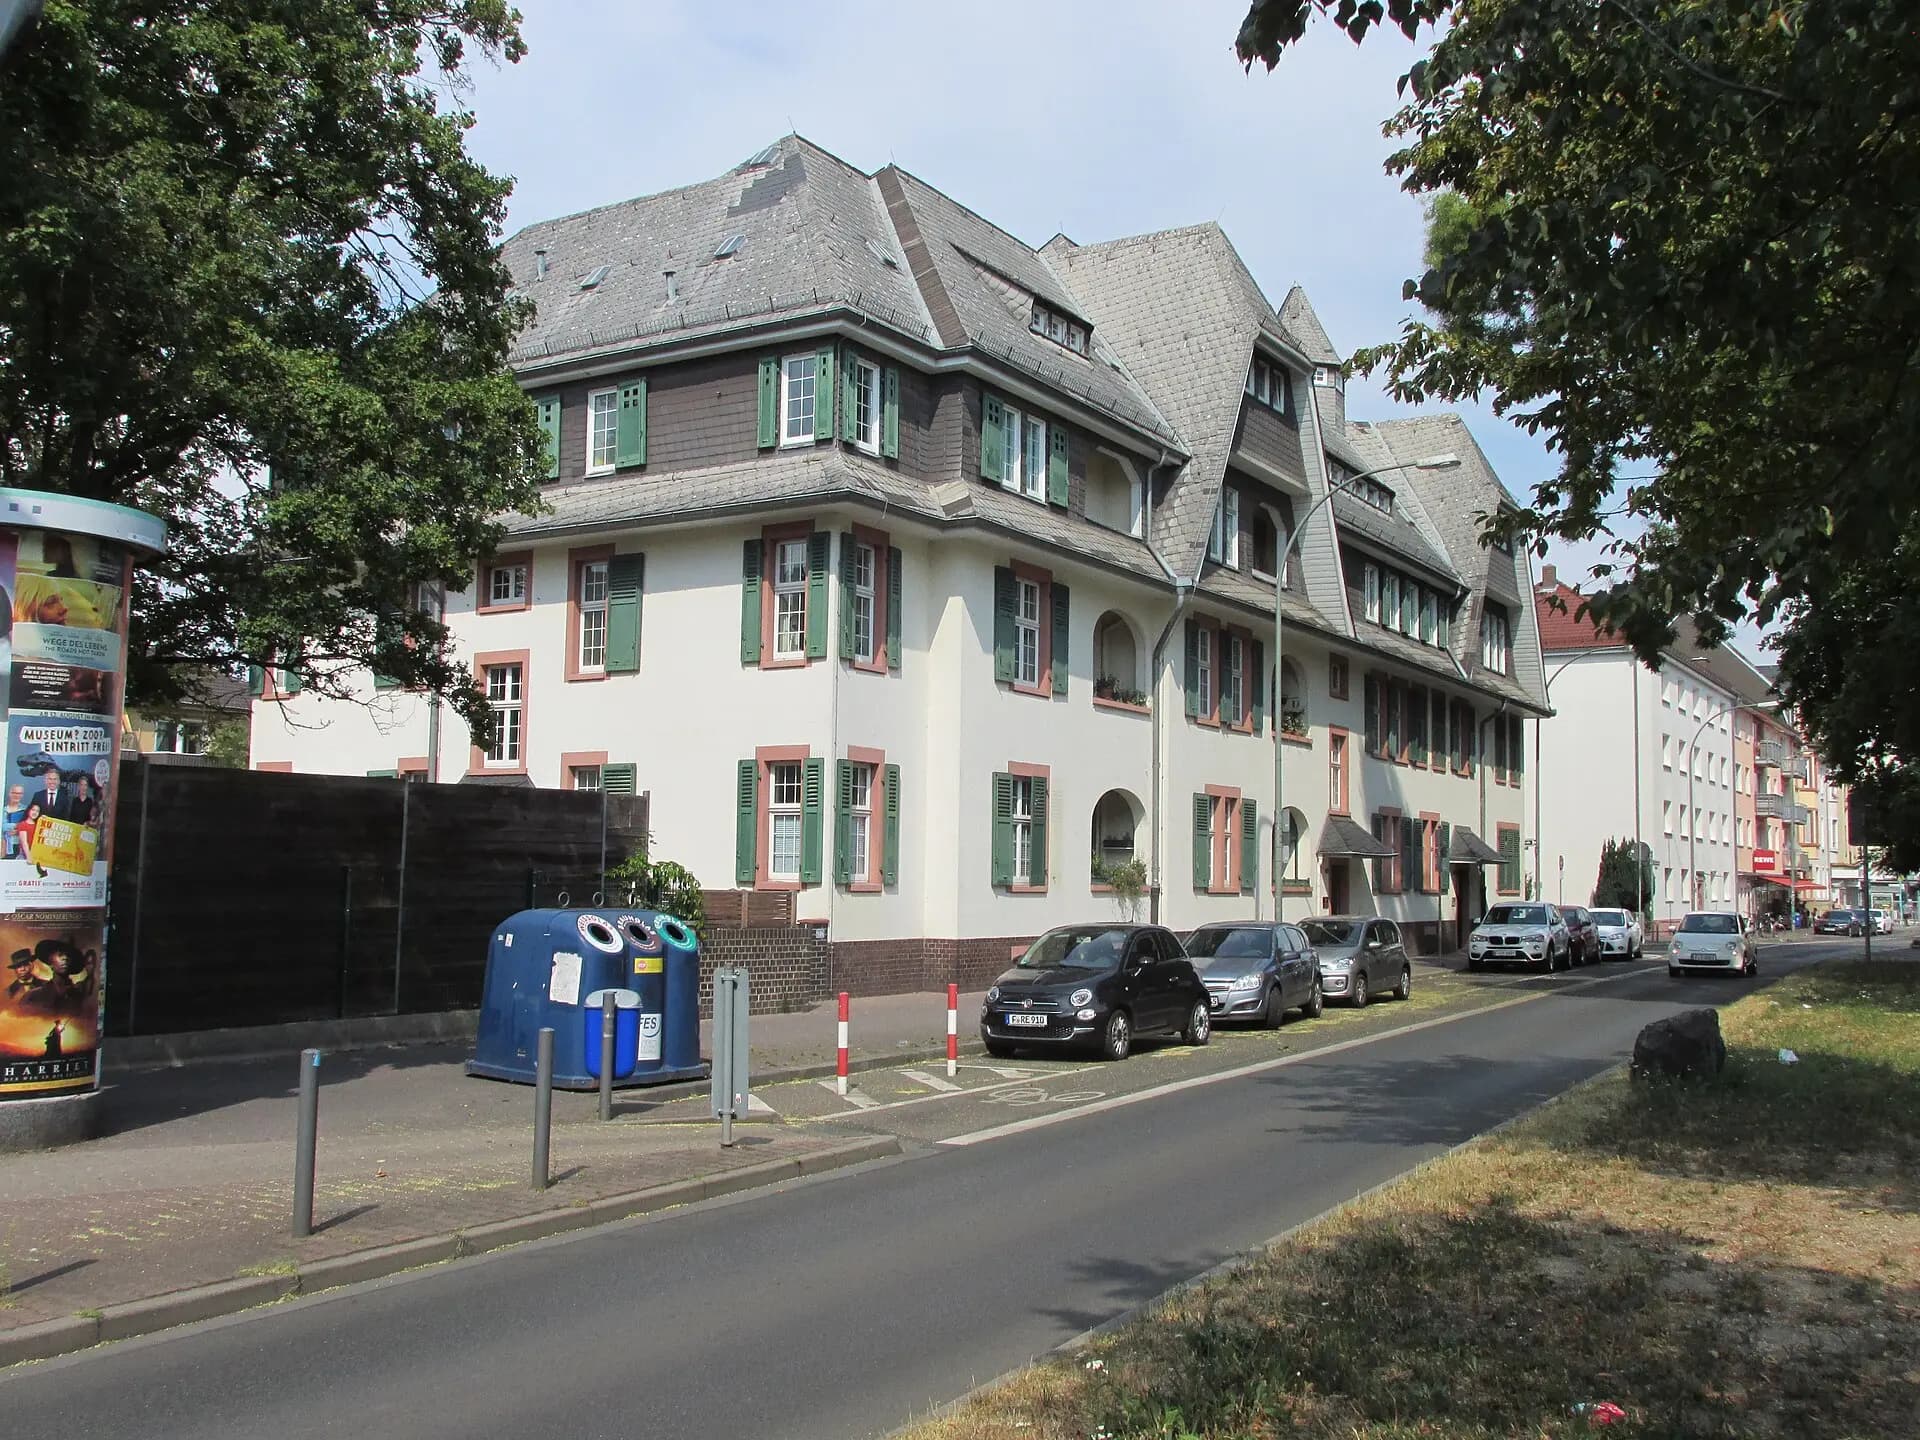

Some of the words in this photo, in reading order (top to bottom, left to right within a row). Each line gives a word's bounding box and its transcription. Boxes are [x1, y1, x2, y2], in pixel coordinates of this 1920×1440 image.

[43, 638, 67, 646] WEGE
[69, 640, 83, 648] DES
[84, 642, 108, 651] LEBENS
[24, 730, 79, 740] MUSEUM?
[83, 730, 103, 740] ZOO?
[44, 742, 90, 752] EINTRITT
[640, 1017, 657, 1029] FES
[5, 1061, 89, 1076] HARRIET
